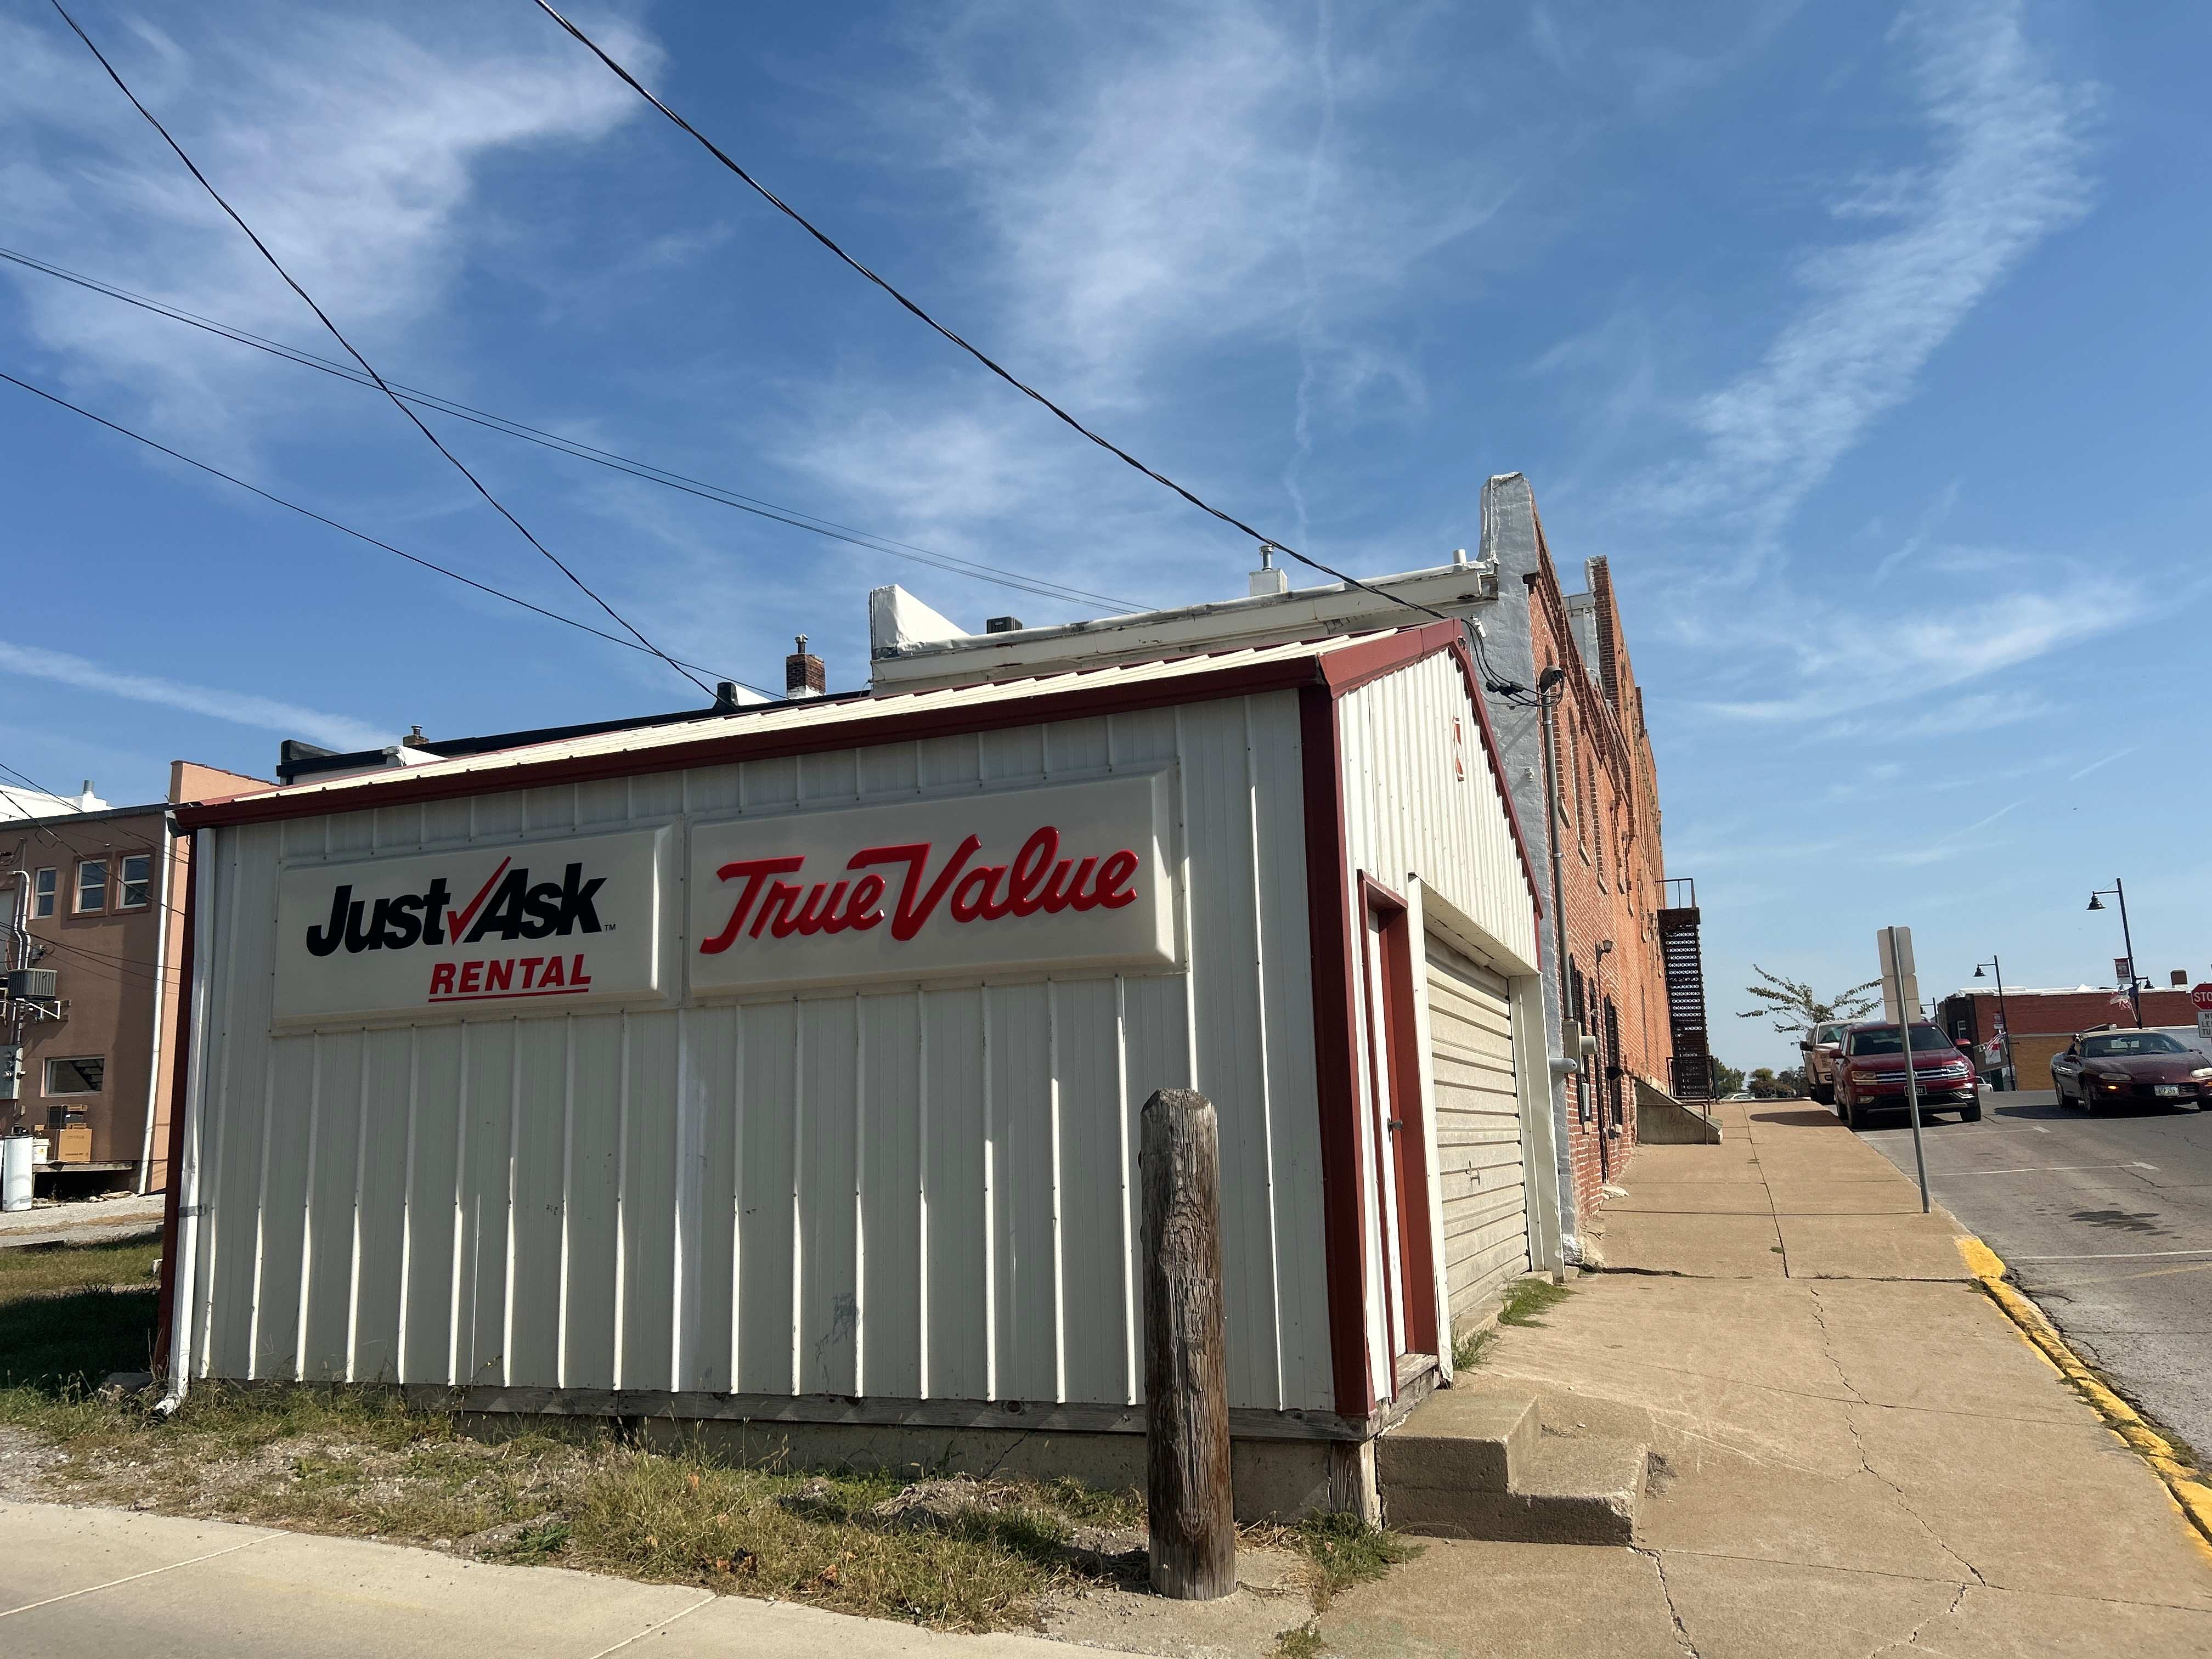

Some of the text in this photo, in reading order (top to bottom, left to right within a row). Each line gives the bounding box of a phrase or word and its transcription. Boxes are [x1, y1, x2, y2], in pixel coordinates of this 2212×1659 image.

[306, 862, 616, 957] Just Ask TM
[699, 826, 1139, 955] True Value
[430, 953, 591, 995] RENTAL
